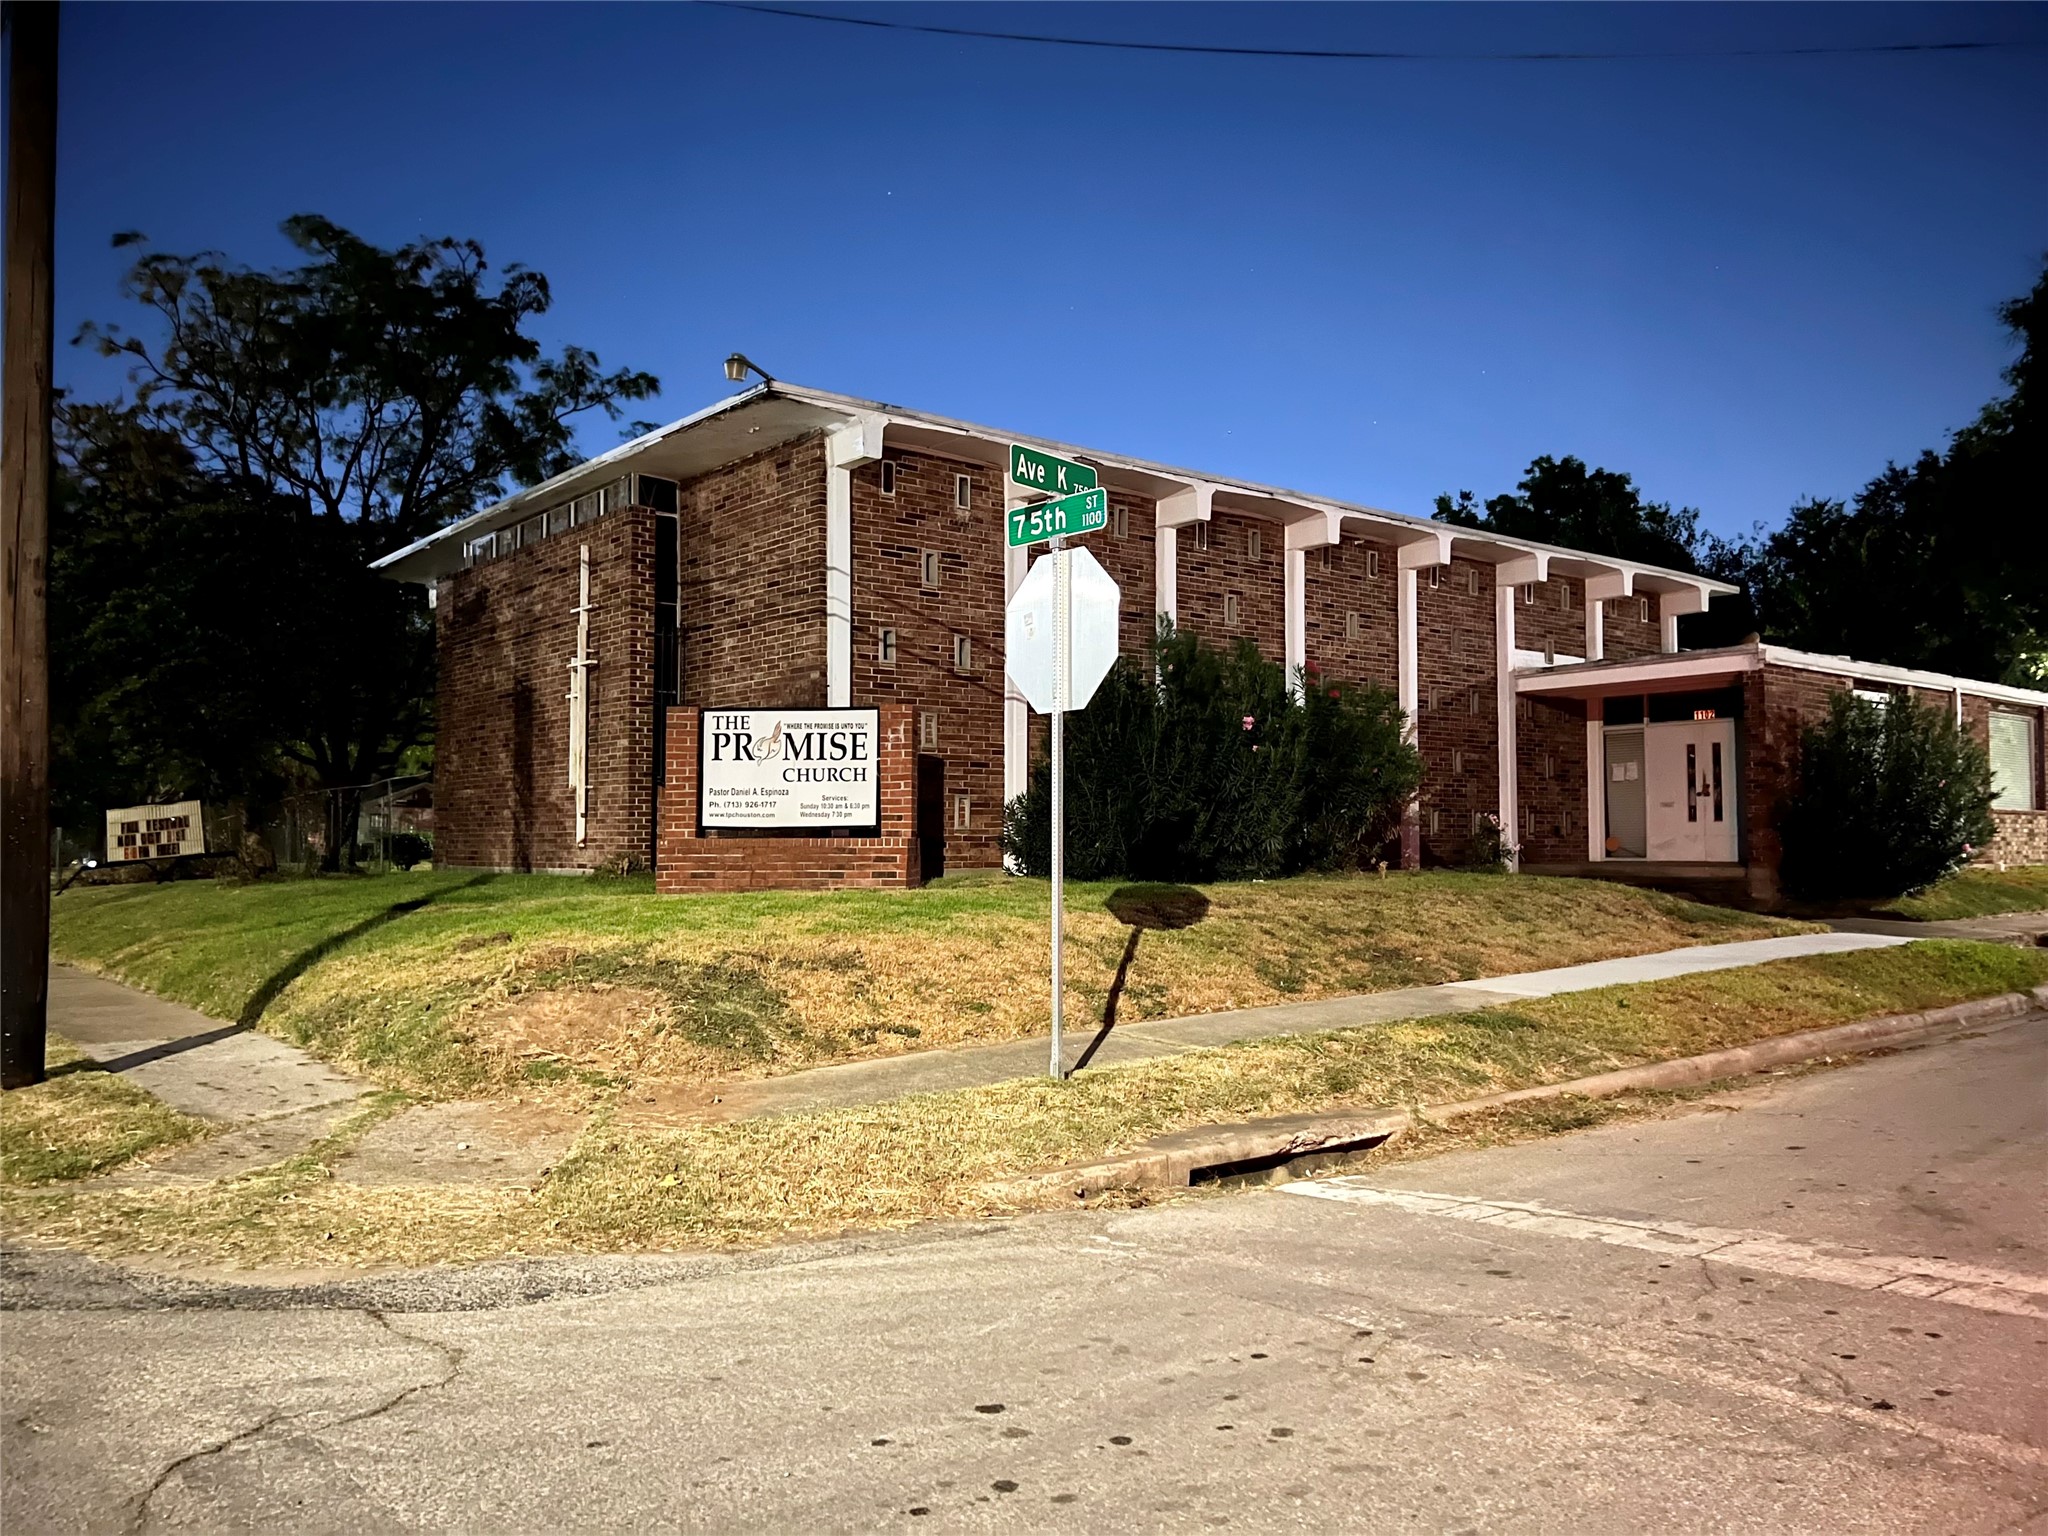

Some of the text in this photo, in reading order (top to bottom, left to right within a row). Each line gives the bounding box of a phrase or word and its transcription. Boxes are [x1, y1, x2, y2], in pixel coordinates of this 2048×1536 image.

[1016, 453, 1068, 491] Ave K
[1012, 494, 1098, 539] 75th ST
[1081, 510, 1102, 527] 1100
[1694, 710, 1715, 720] 1102
[712, 715, 750, 730] THE
[804, 722, 813, 730] THE
[814, 722, 834, 730] PROMISE
[835, 722, 840, 730] IS
[841, 722, 854, 730] UNTO
[782, 767, 867, 783] CHURCH
[709, 787, 789, 797] Pastor Daniel A. Espinoza
[800, 802, 820, 810] Sunday
[800, 811, 830, 819] Wednesday
